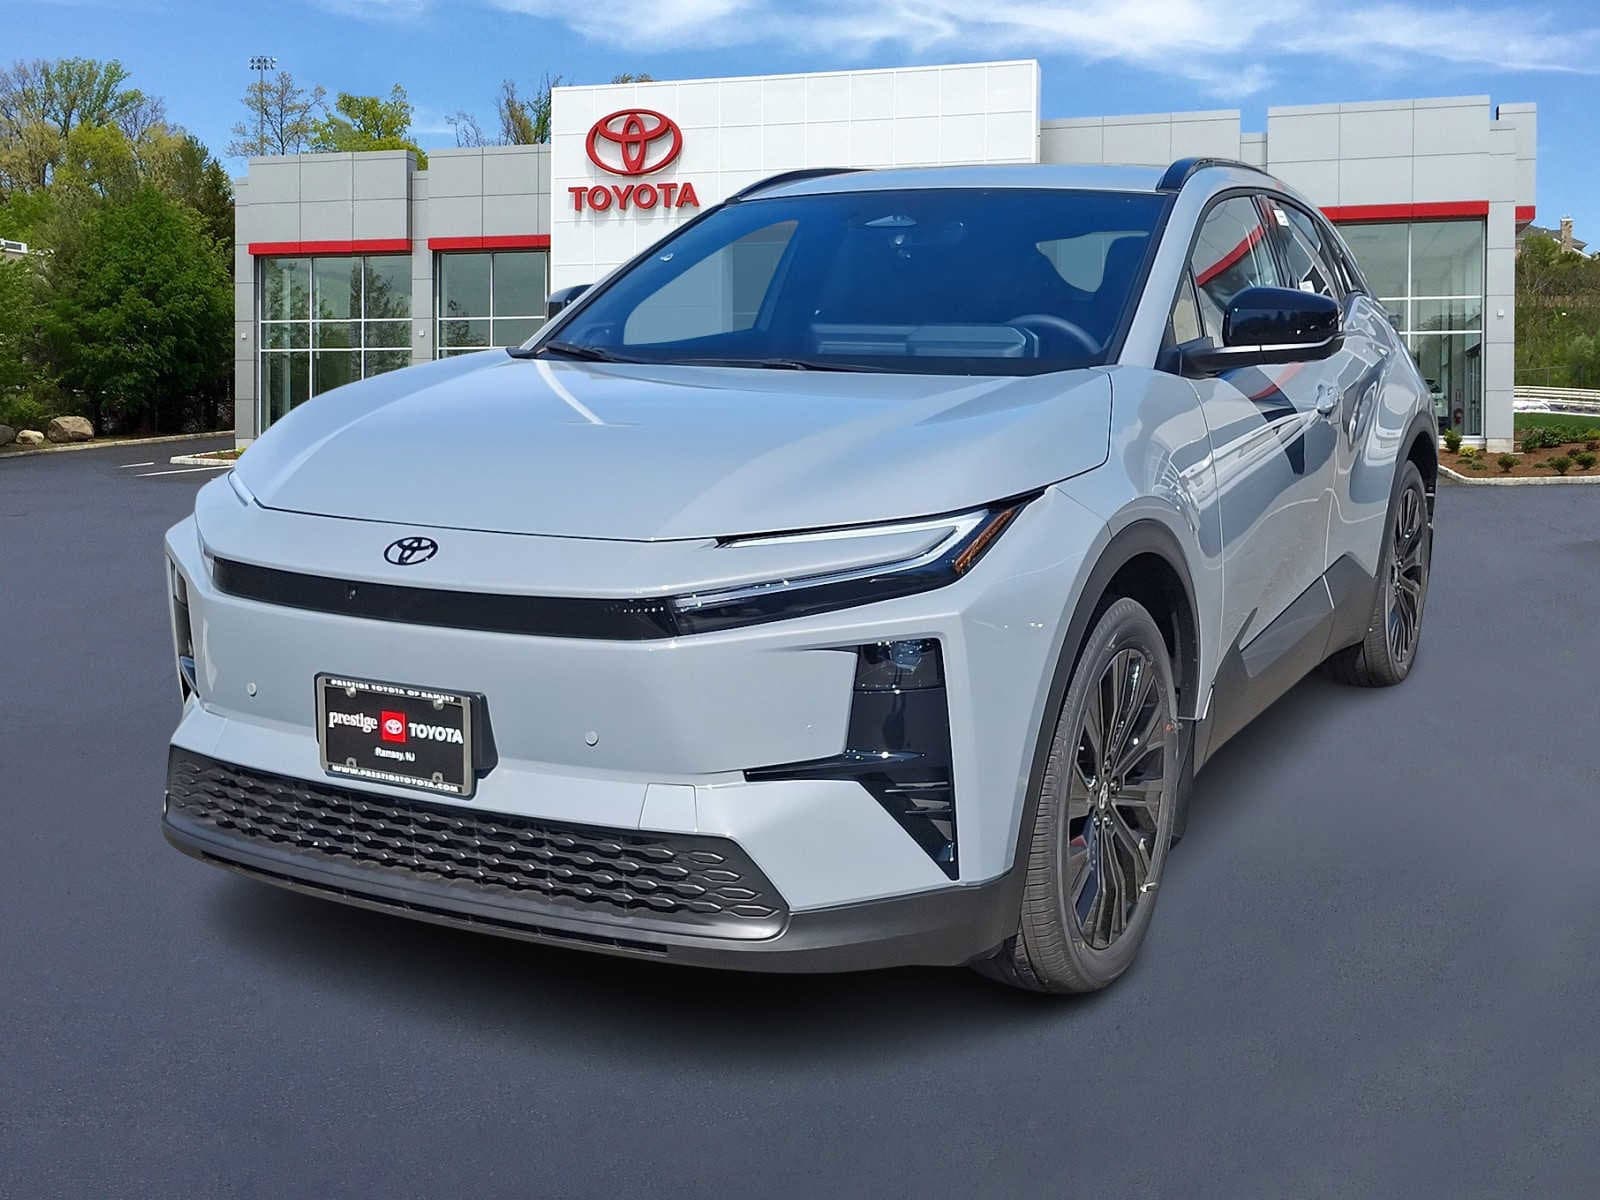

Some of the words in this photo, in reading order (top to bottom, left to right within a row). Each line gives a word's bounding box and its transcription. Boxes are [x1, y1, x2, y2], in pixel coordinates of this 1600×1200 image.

[568, 182, 700, 212] TOYOTA
[371, 684, 405, 695] TOYOTA
[407, 689, 420, 697] OF
[328, 711, 378, 733] prestige
[408, 722, 464, 745] TOYOTA
[405, 751, 416, 762] NJ
